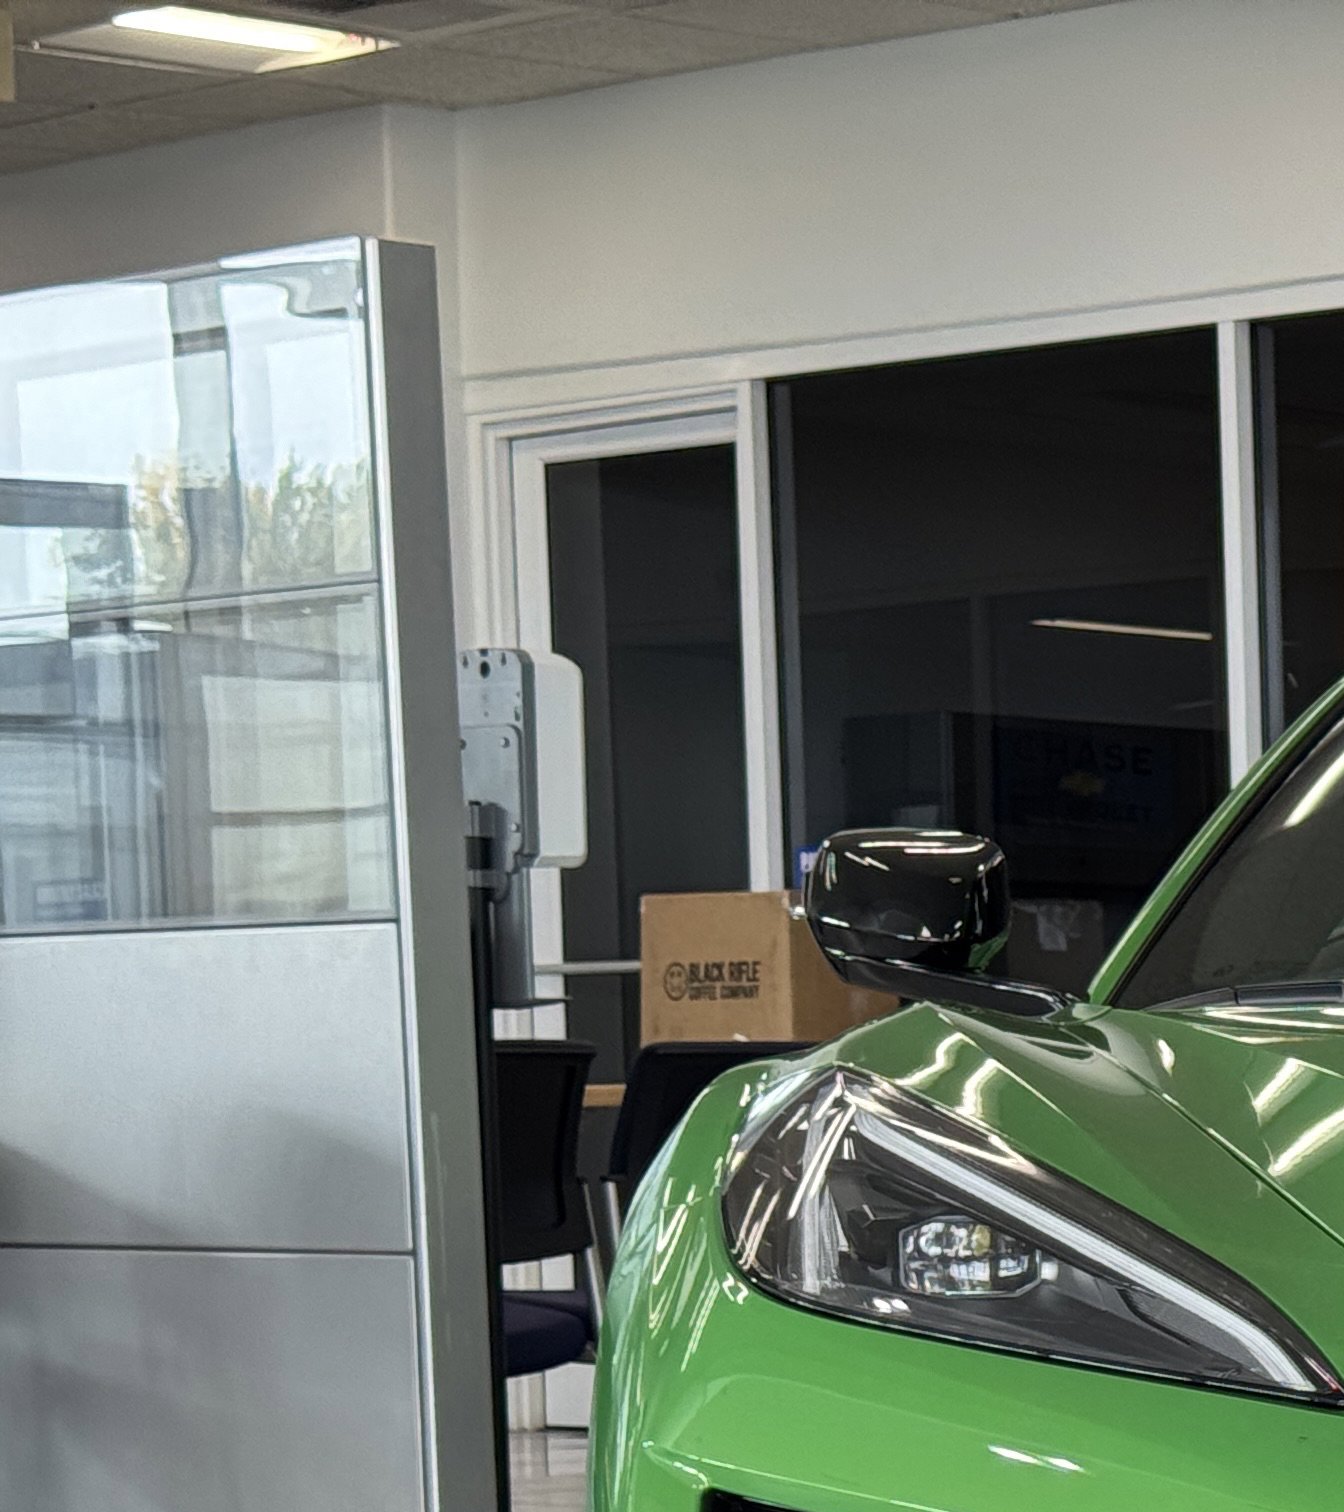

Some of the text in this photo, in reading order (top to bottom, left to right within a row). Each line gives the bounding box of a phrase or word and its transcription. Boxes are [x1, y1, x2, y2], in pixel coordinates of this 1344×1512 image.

[688, 960, 761, 983] BLACK RIFLE
[688, 985, 760, 1000] COFFEE COMPANY
